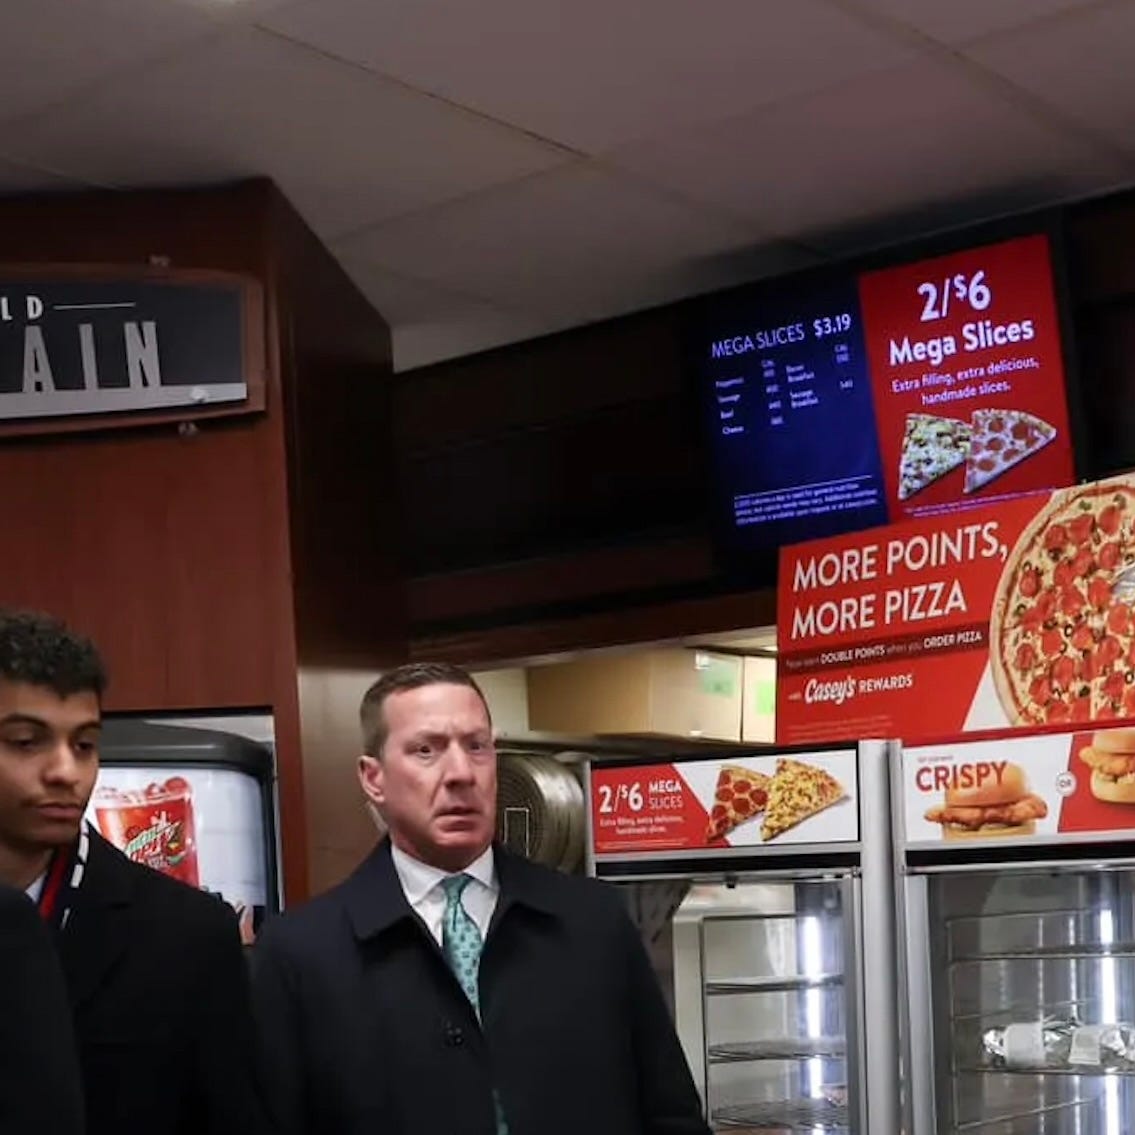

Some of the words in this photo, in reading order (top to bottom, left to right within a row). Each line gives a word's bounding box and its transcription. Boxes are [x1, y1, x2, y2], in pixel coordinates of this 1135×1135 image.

[916, 270, 992, 323] 2/$6
[712, 335, 755, 359] MEGA
[755, 323, 805, 350] SLICES
[812, 313, 851, 339] $3.19
[888, 337, 957, 368] Mega
[961, 319, 1036, 353] Slices
[892, 379, 919, 393] Extra
[921, 373, 956, 386] filling,
[957, 367, 985, 381] extra
[987, 357, 1039, 374] delicious,
[921, 386, 977, 405] handmade
[979, 380, 1011, 395] slices.
[793, 546, 878, 592] MORE
[886, 521, 1008, 575] POINTS,
[791, 594, 876, 640] MORE
[885, 579, 967, 624] PIZZA
[821, 650, 852, 664] DOUBLE
[855, 645, 885, 659] POINTS
[923, 634, 954, 649] ORDER
[956, 631, 982, 644] PIZZA
[804, 676, 856, 704] Casey's
[859, 674, 913, 693] REWARDS
[649, 780, 682, 793] MEGA
[915, 760, 1007, 792] CRISPY
[599, 782, 643, 813] 2/$6
[649, 795, 683, 809] SLICES
